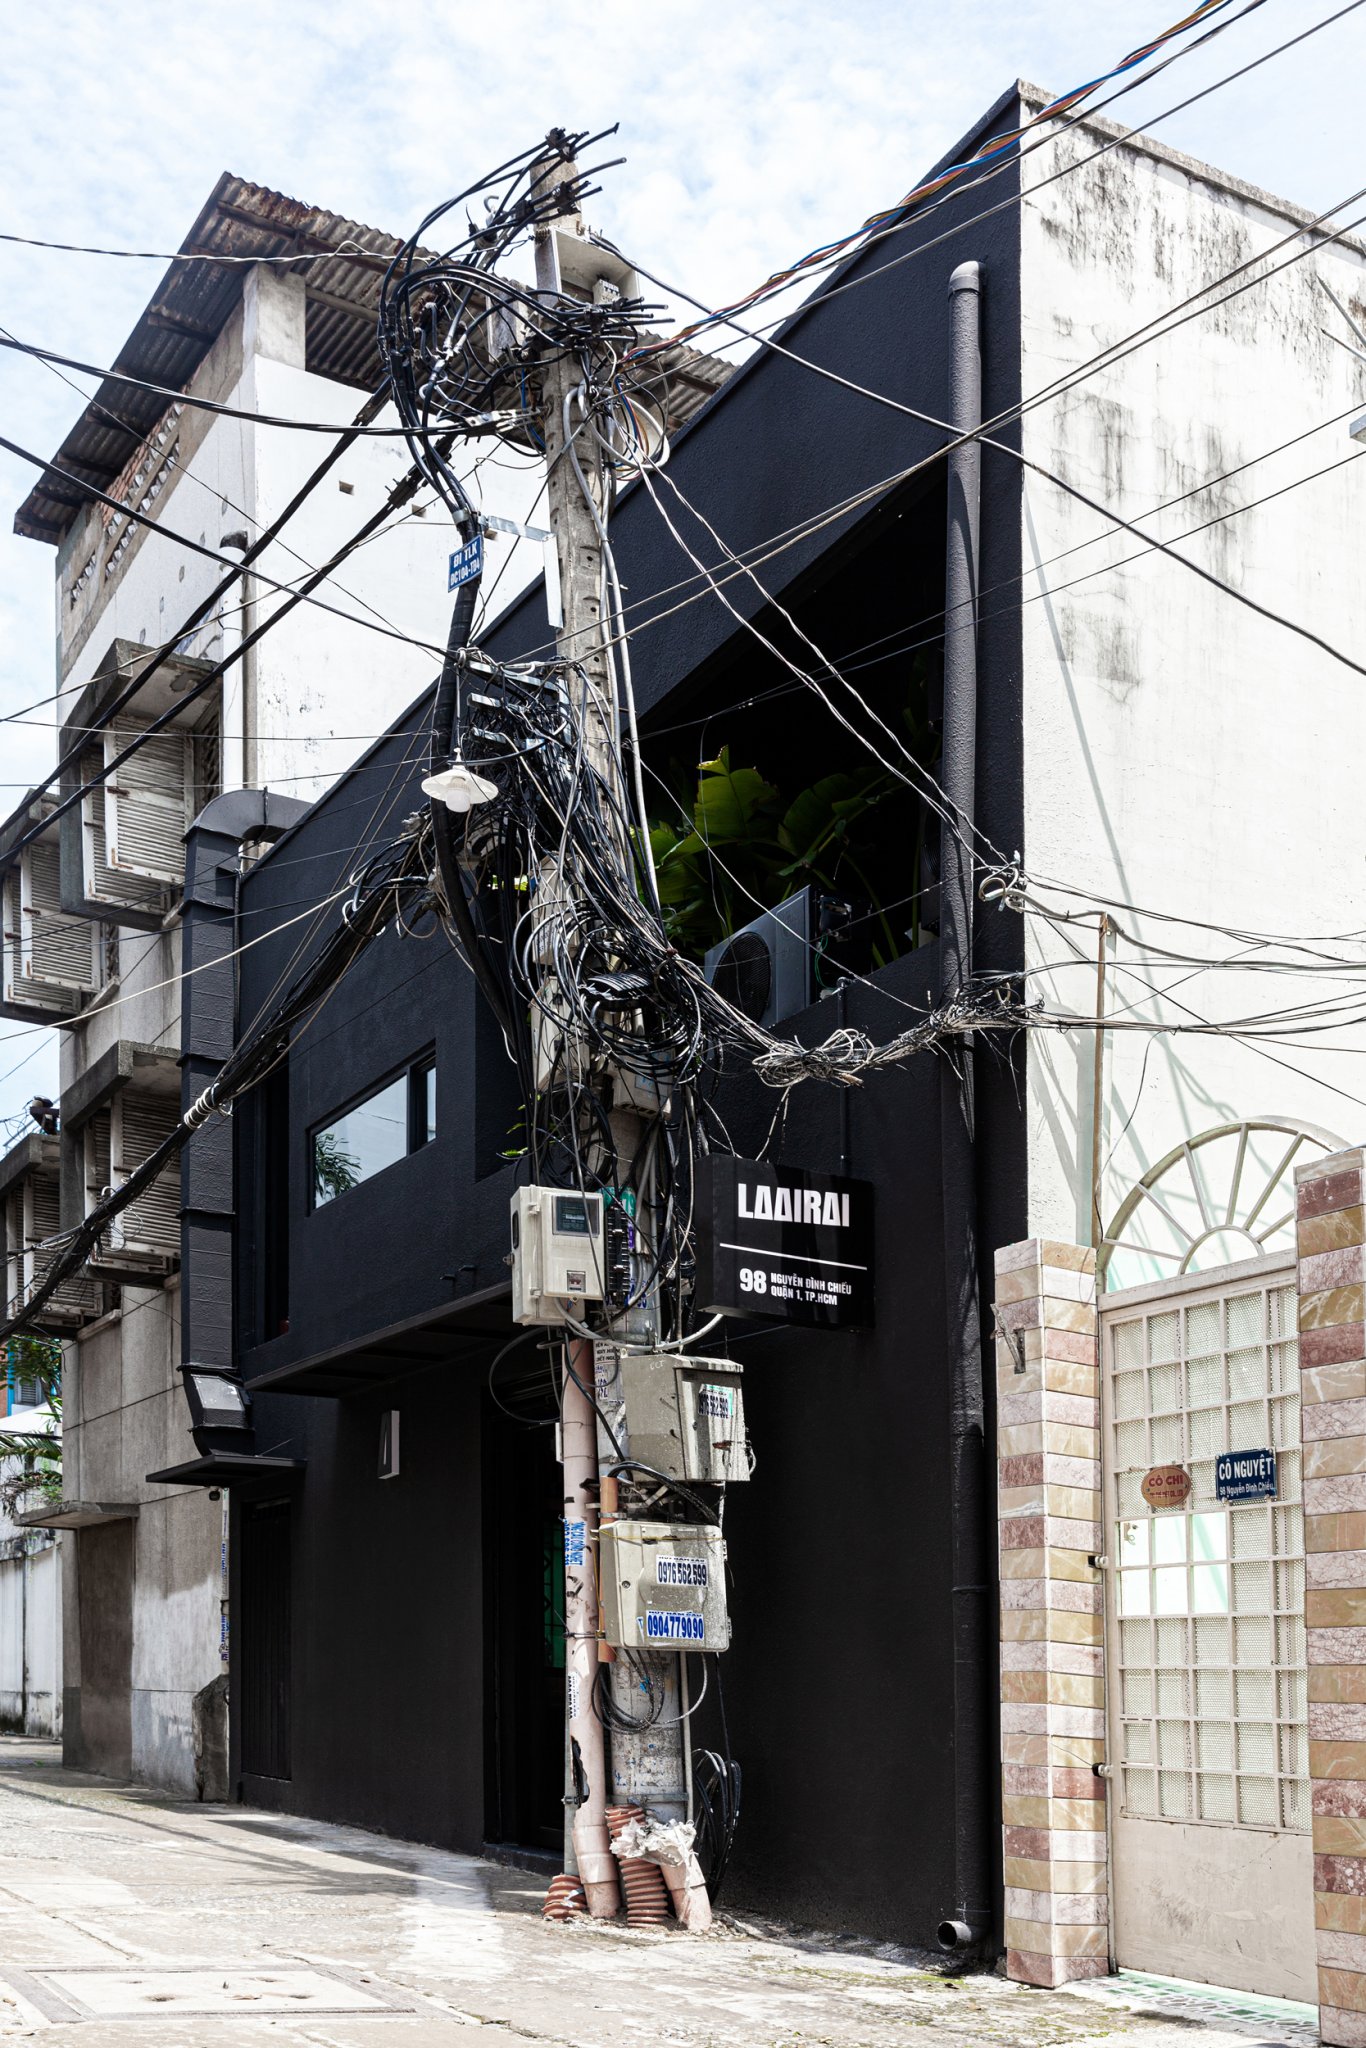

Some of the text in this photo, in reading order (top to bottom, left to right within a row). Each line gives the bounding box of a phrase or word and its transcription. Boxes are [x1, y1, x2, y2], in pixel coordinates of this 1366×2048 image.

[738, 1183, 850, 1227] LAAIRAI
[740, 1268, 767, 1294] 98
[770, 1272, 803, 1288] NGUYỄN
[805, 1276, 826, 1291] ĐÌNH
[770, 1285, 794, 1300] QUẬN
[805, 1291, 838, 1306] TP.HCM
[1218, 1453, 1273, 1481] CÔ NGUYỆT
[1149, 1474, 1164, 1487] CÔ
